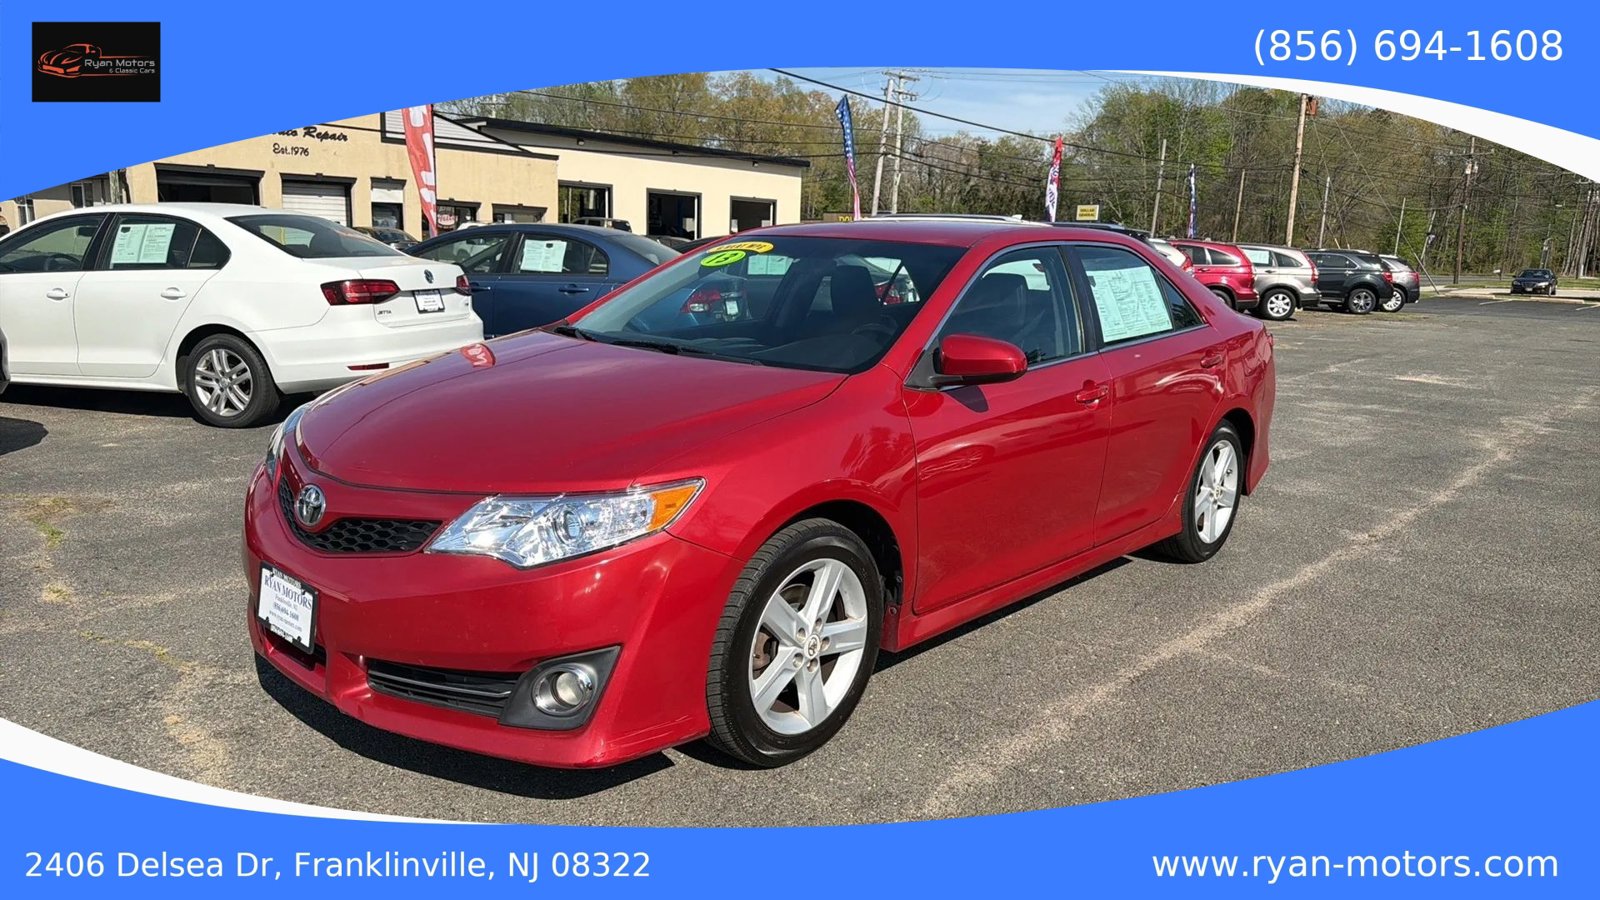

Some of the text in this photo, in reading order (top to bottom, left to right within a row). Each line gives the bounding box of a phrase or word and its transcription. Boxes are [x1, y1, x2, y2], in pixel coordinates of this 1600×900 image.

[272, 126, 349, 142] to Repair
[264, 574, 281, 594] RYAN
[282, 584, 313, 611] MOTORS
